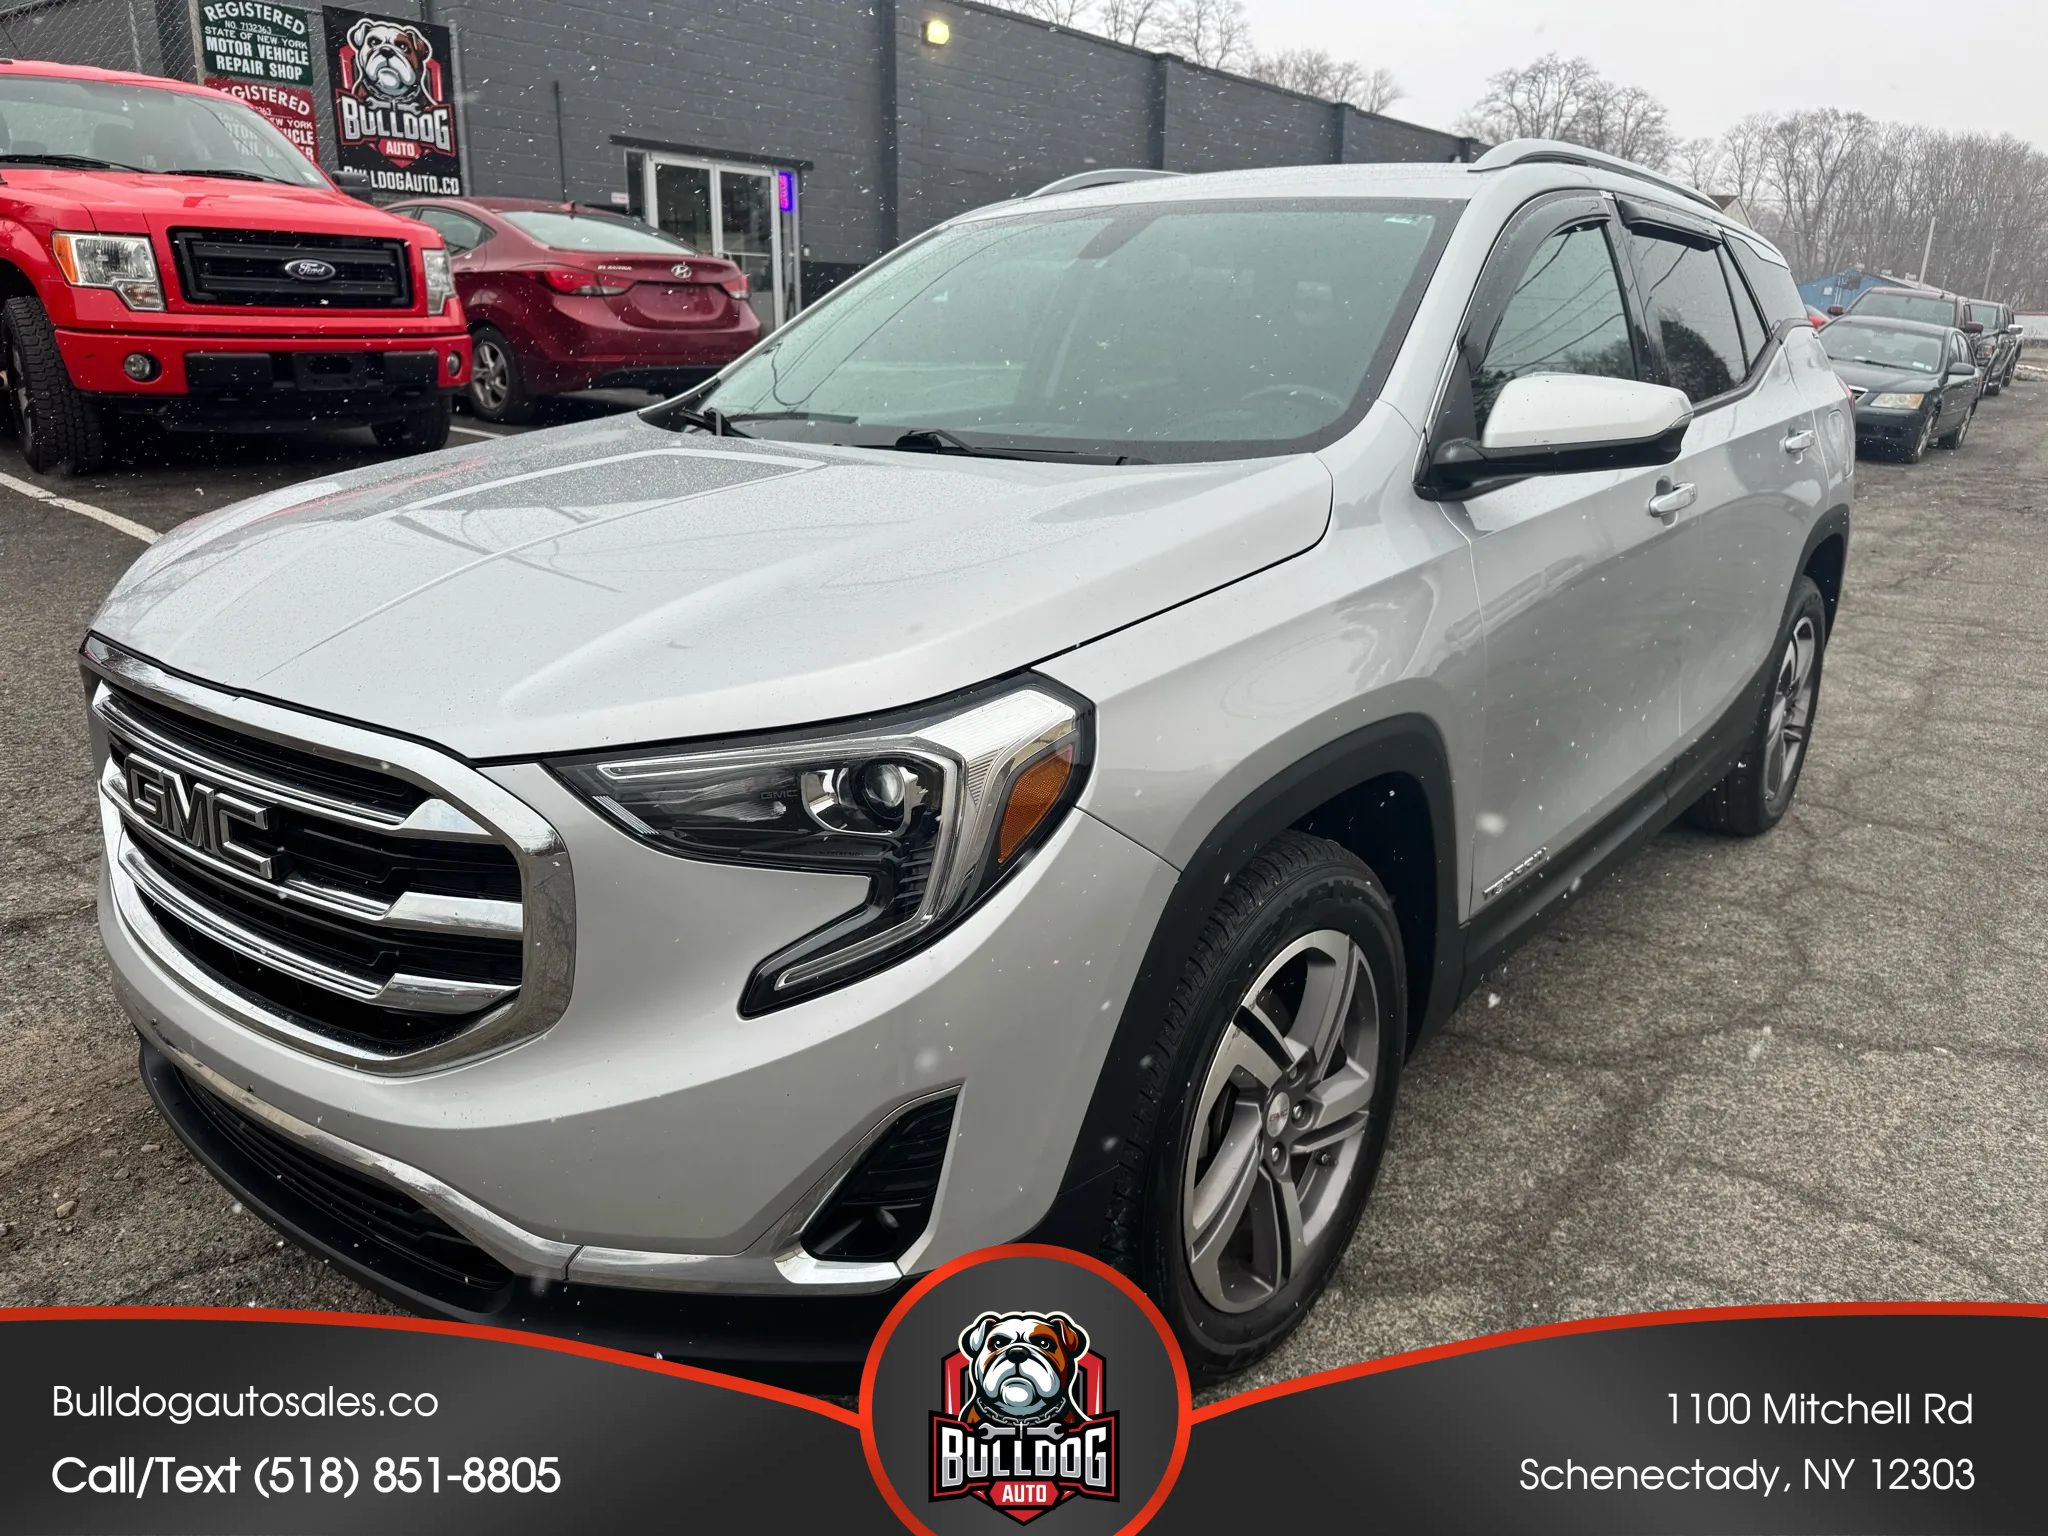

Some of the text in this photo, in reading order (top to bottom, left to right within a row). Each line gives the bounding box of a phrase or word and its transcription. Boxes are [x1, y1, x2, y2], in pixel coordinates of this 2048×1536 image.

[203, 2, 305, 35] REGISTERED
[224, 20, 238, 30] NO.
[204, 26, 308, 50] STATE OF NEW YORK
[205, 36, 309, 66] MOTOR VEHICLE
[216, 54, 303, 81] REPAIR SHOP
[221, 85, 310, 116] GISTERED
[287, 118, 312, 130] YORK
[341, 95, 451, 152] BULLDOG
[385, 140, 416, 158] AUTO
[299, 263, 325, 275] Ford
[760, 789, 799, 800] GMC
[124, 752, 273, 880] GMC
